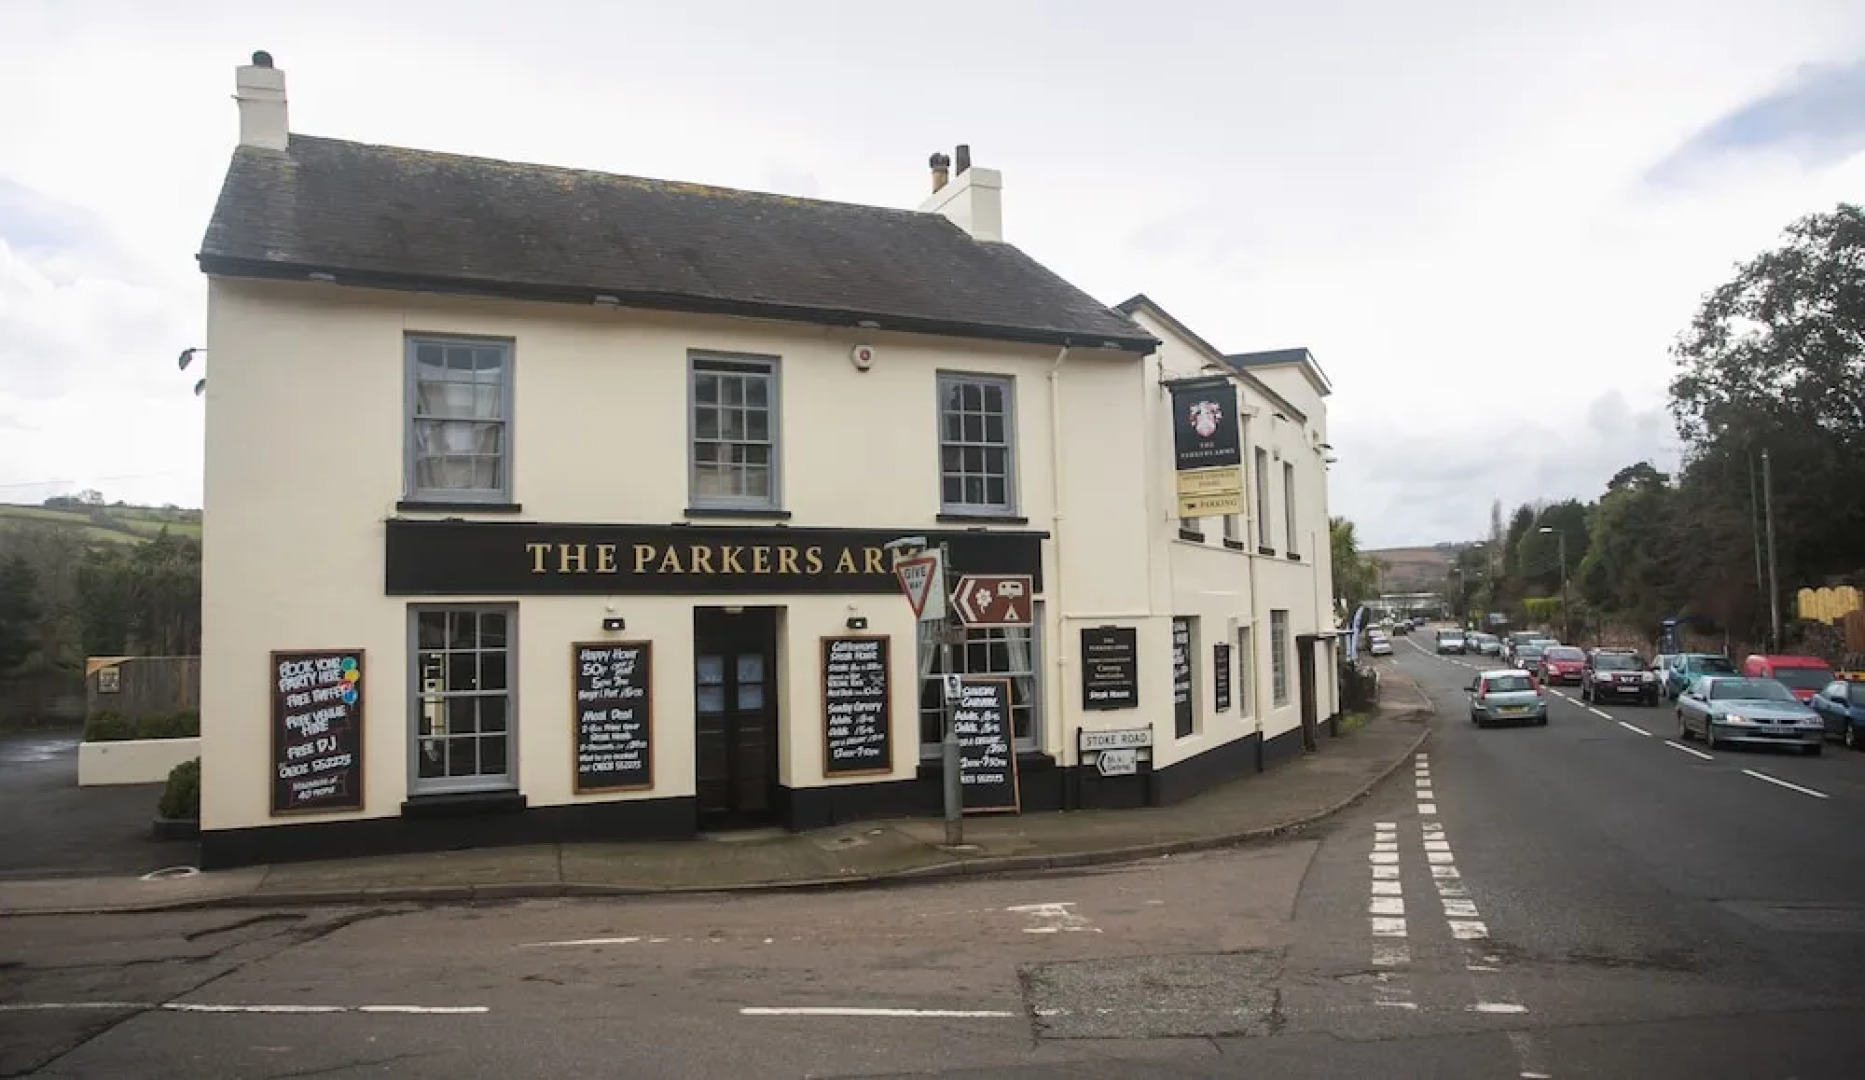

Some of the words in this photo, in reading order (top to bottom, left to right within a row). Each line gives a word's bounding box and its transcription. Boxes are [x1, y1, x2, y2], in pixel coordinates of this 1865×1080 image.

[526, 543, 618, 574] THE
[633, 545, 824, 574] PARKERS
[834, 546, 917, 574] ARM
[904, 566, 926, 579] GIVE
[580, 649, 610, 662] Happy
[612, 647, 638, 661] Hour
[280, 661, 315, 677] BOOK
[315, 657, 341, 671] YOUR
[278, 671, 317, 692] PARTY
[318, 668, 341, 682] HERE
[287, 693, 311, 707] FREE
[286, 715, 314, 729] FREE
[313, 705, 345, 721] VENUE
[287, 742, 314, 759] FREE
[316, 735, 336, 753] DJ
[1086, 736, 1115, 747] STOKE
[1122, 732, 1148, 743] ROAD
